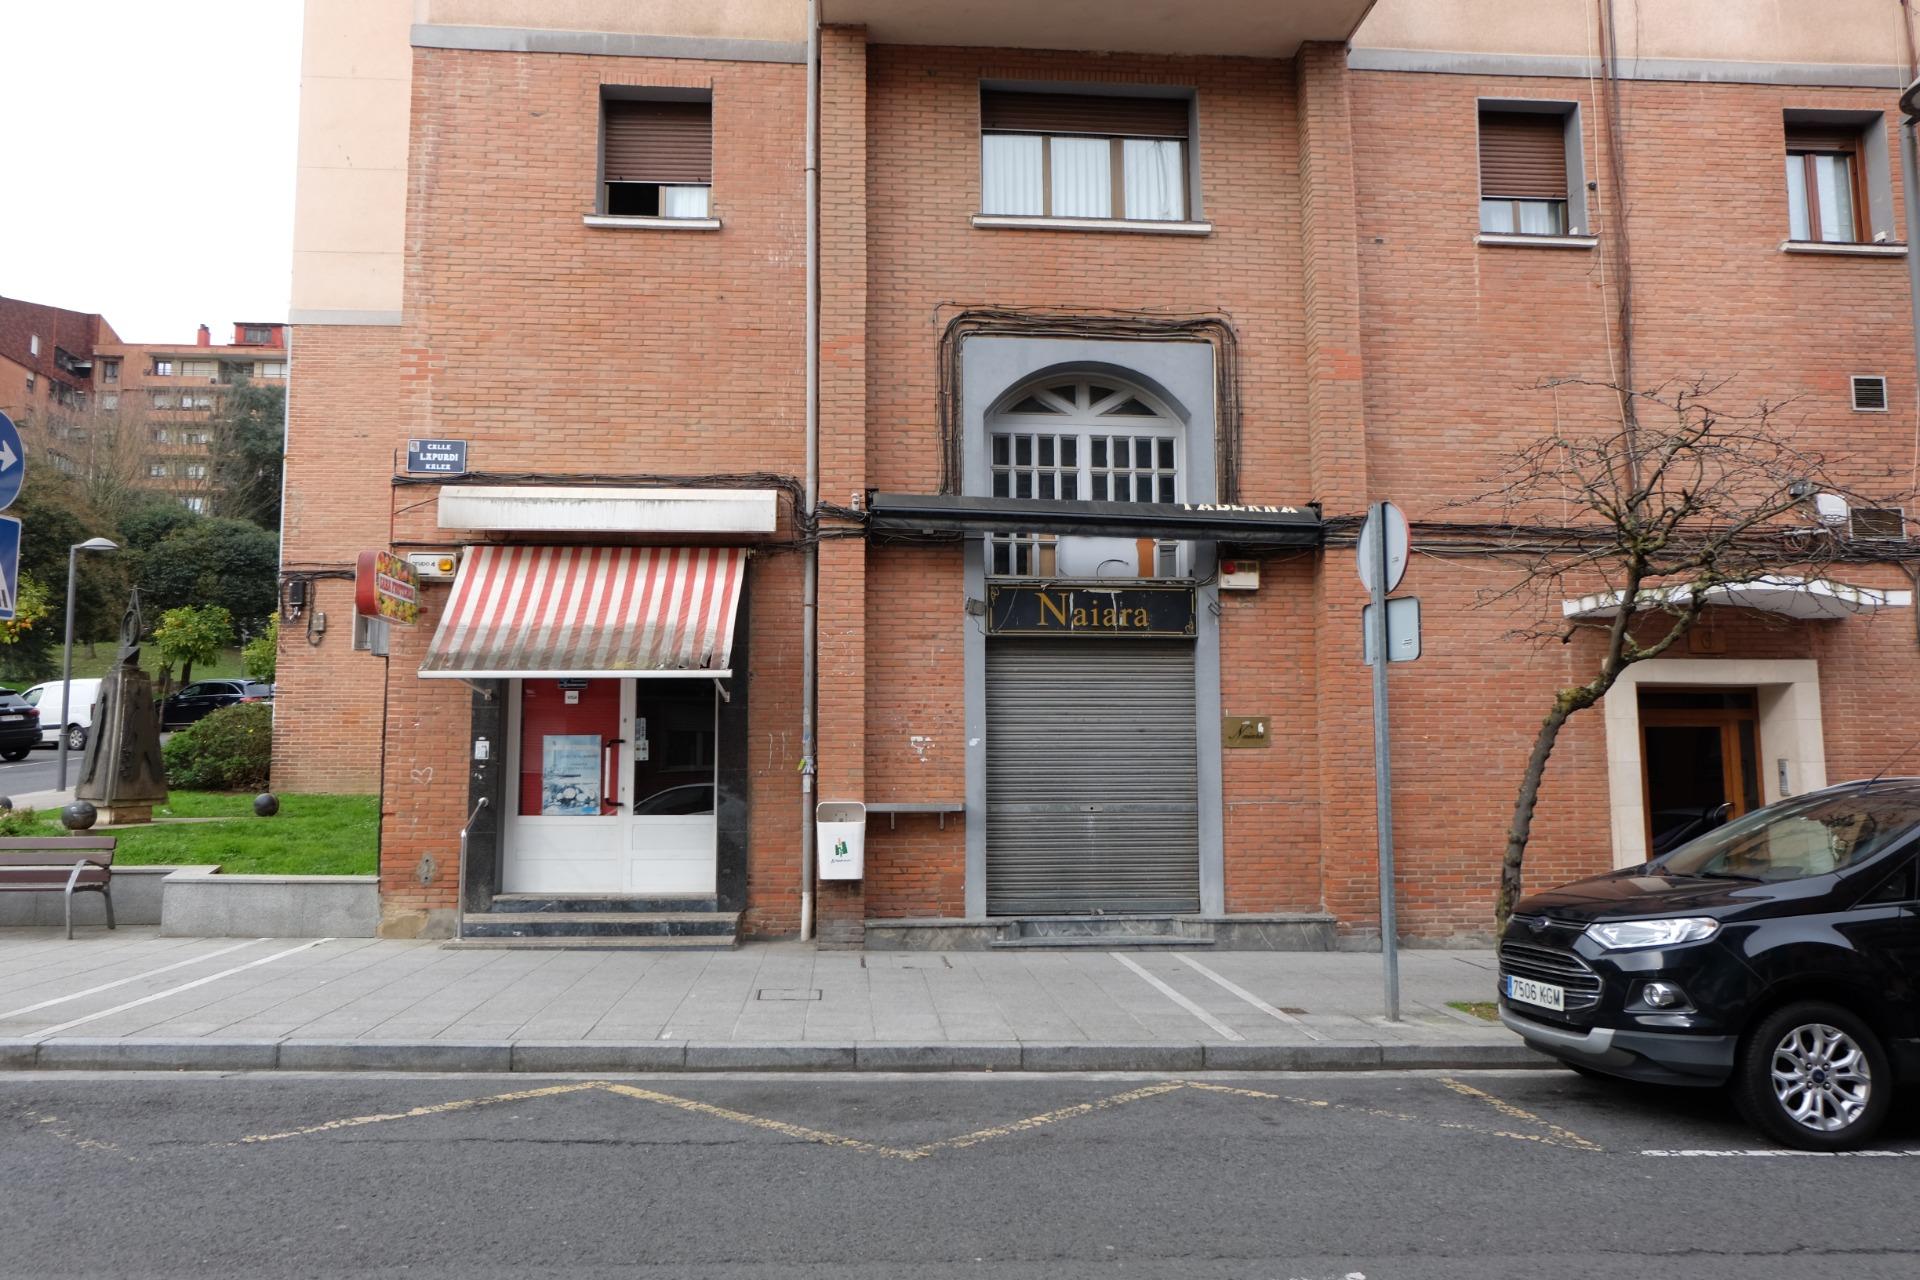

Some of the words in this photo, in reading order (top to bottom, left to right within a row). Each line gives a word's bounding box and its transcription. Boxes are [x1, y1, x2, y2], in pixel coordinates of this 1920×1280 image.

[419, 452, 459, 461] LAPURDI
[1034, 592, 1150, 627] Naiara
[1513, 979, 1537, 1001] 7506
[1540, 985, 1560, 1006] KGM
